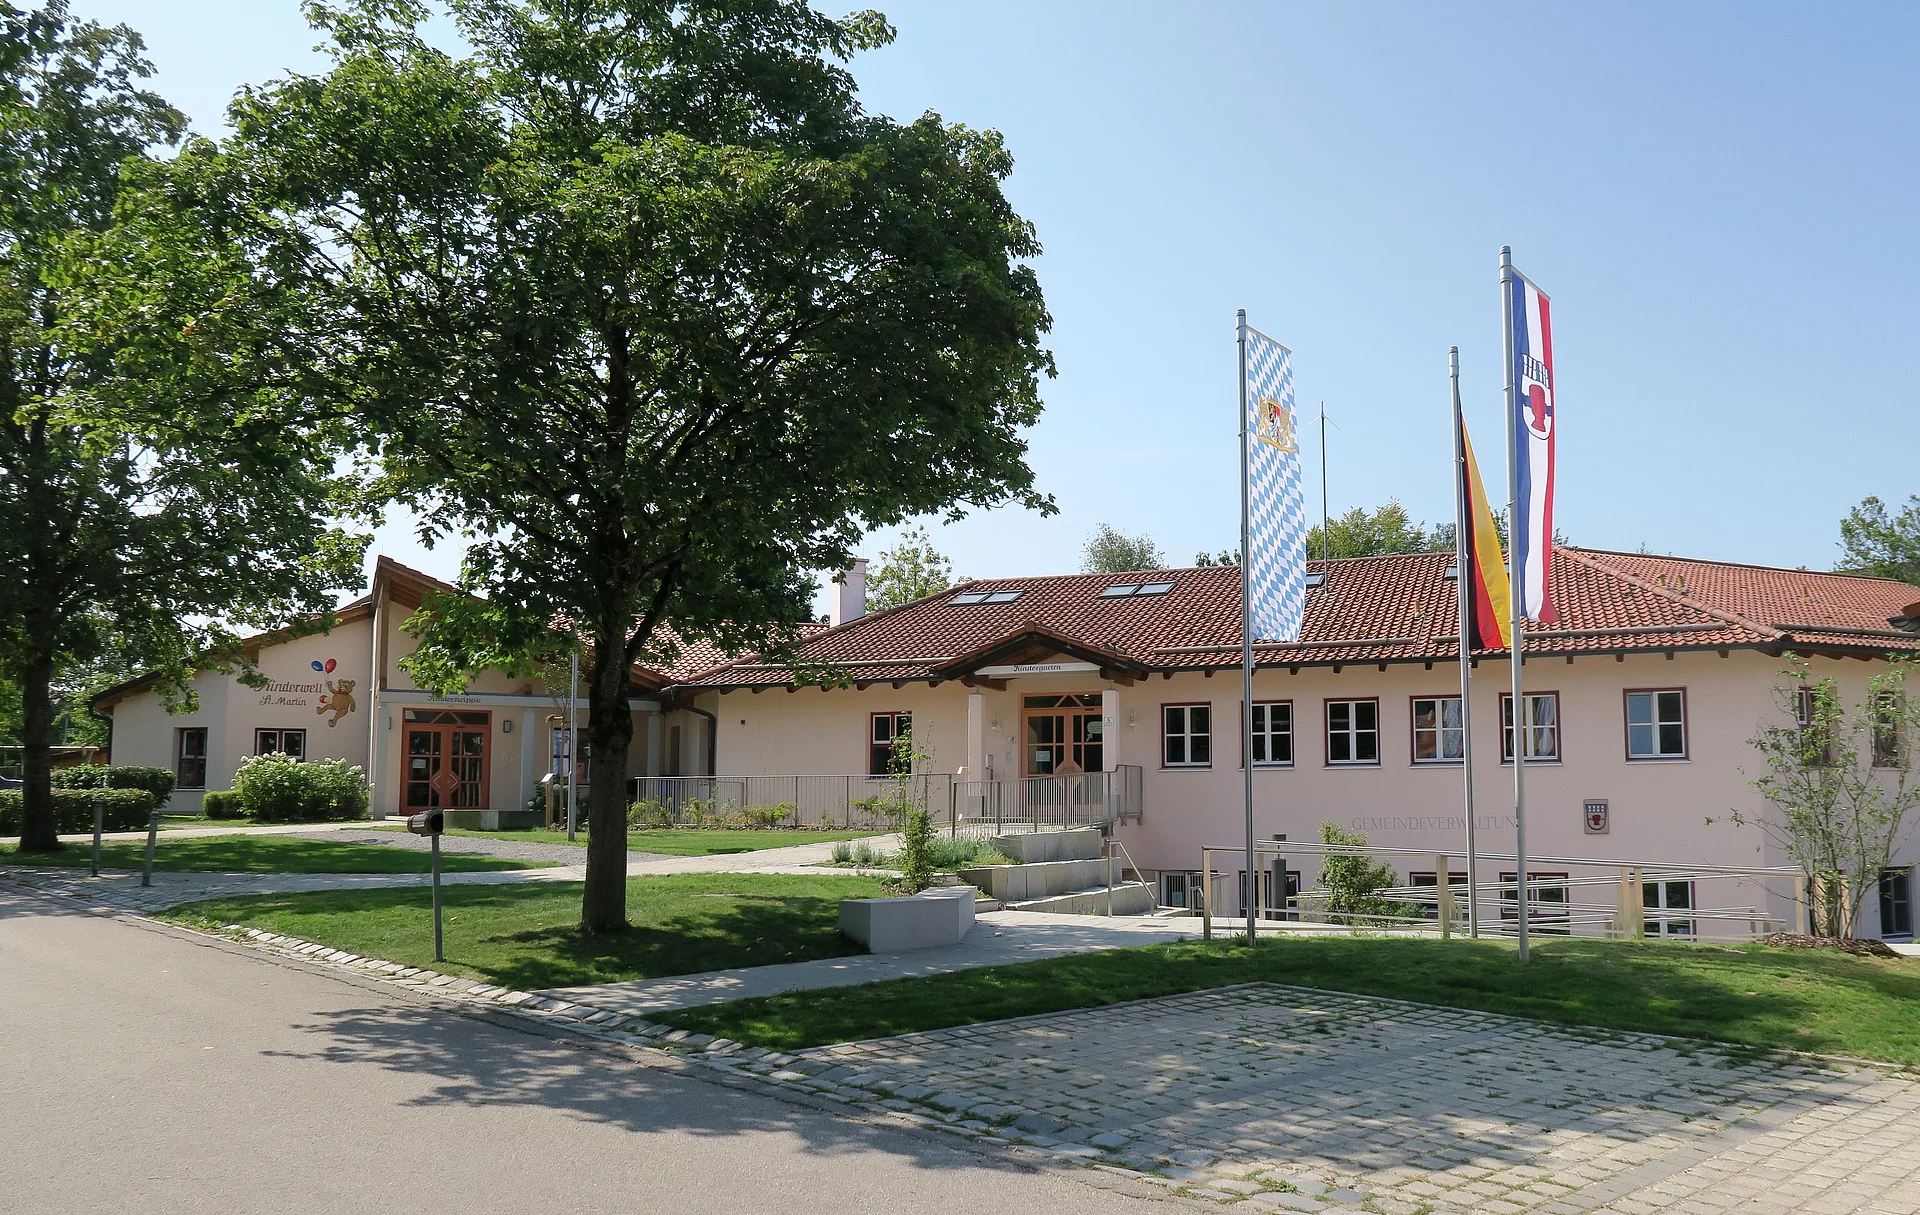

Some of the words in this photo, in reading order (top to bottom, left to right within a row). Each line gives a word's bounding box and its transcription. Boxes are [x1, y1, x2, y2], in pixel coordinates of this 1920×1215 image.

[1013, 665, 1061, 673] Kindergarten
[275, 697, 307, 706] Martin
[1352, 816, 1517, 829] GEMEINDEVERWLTUN
